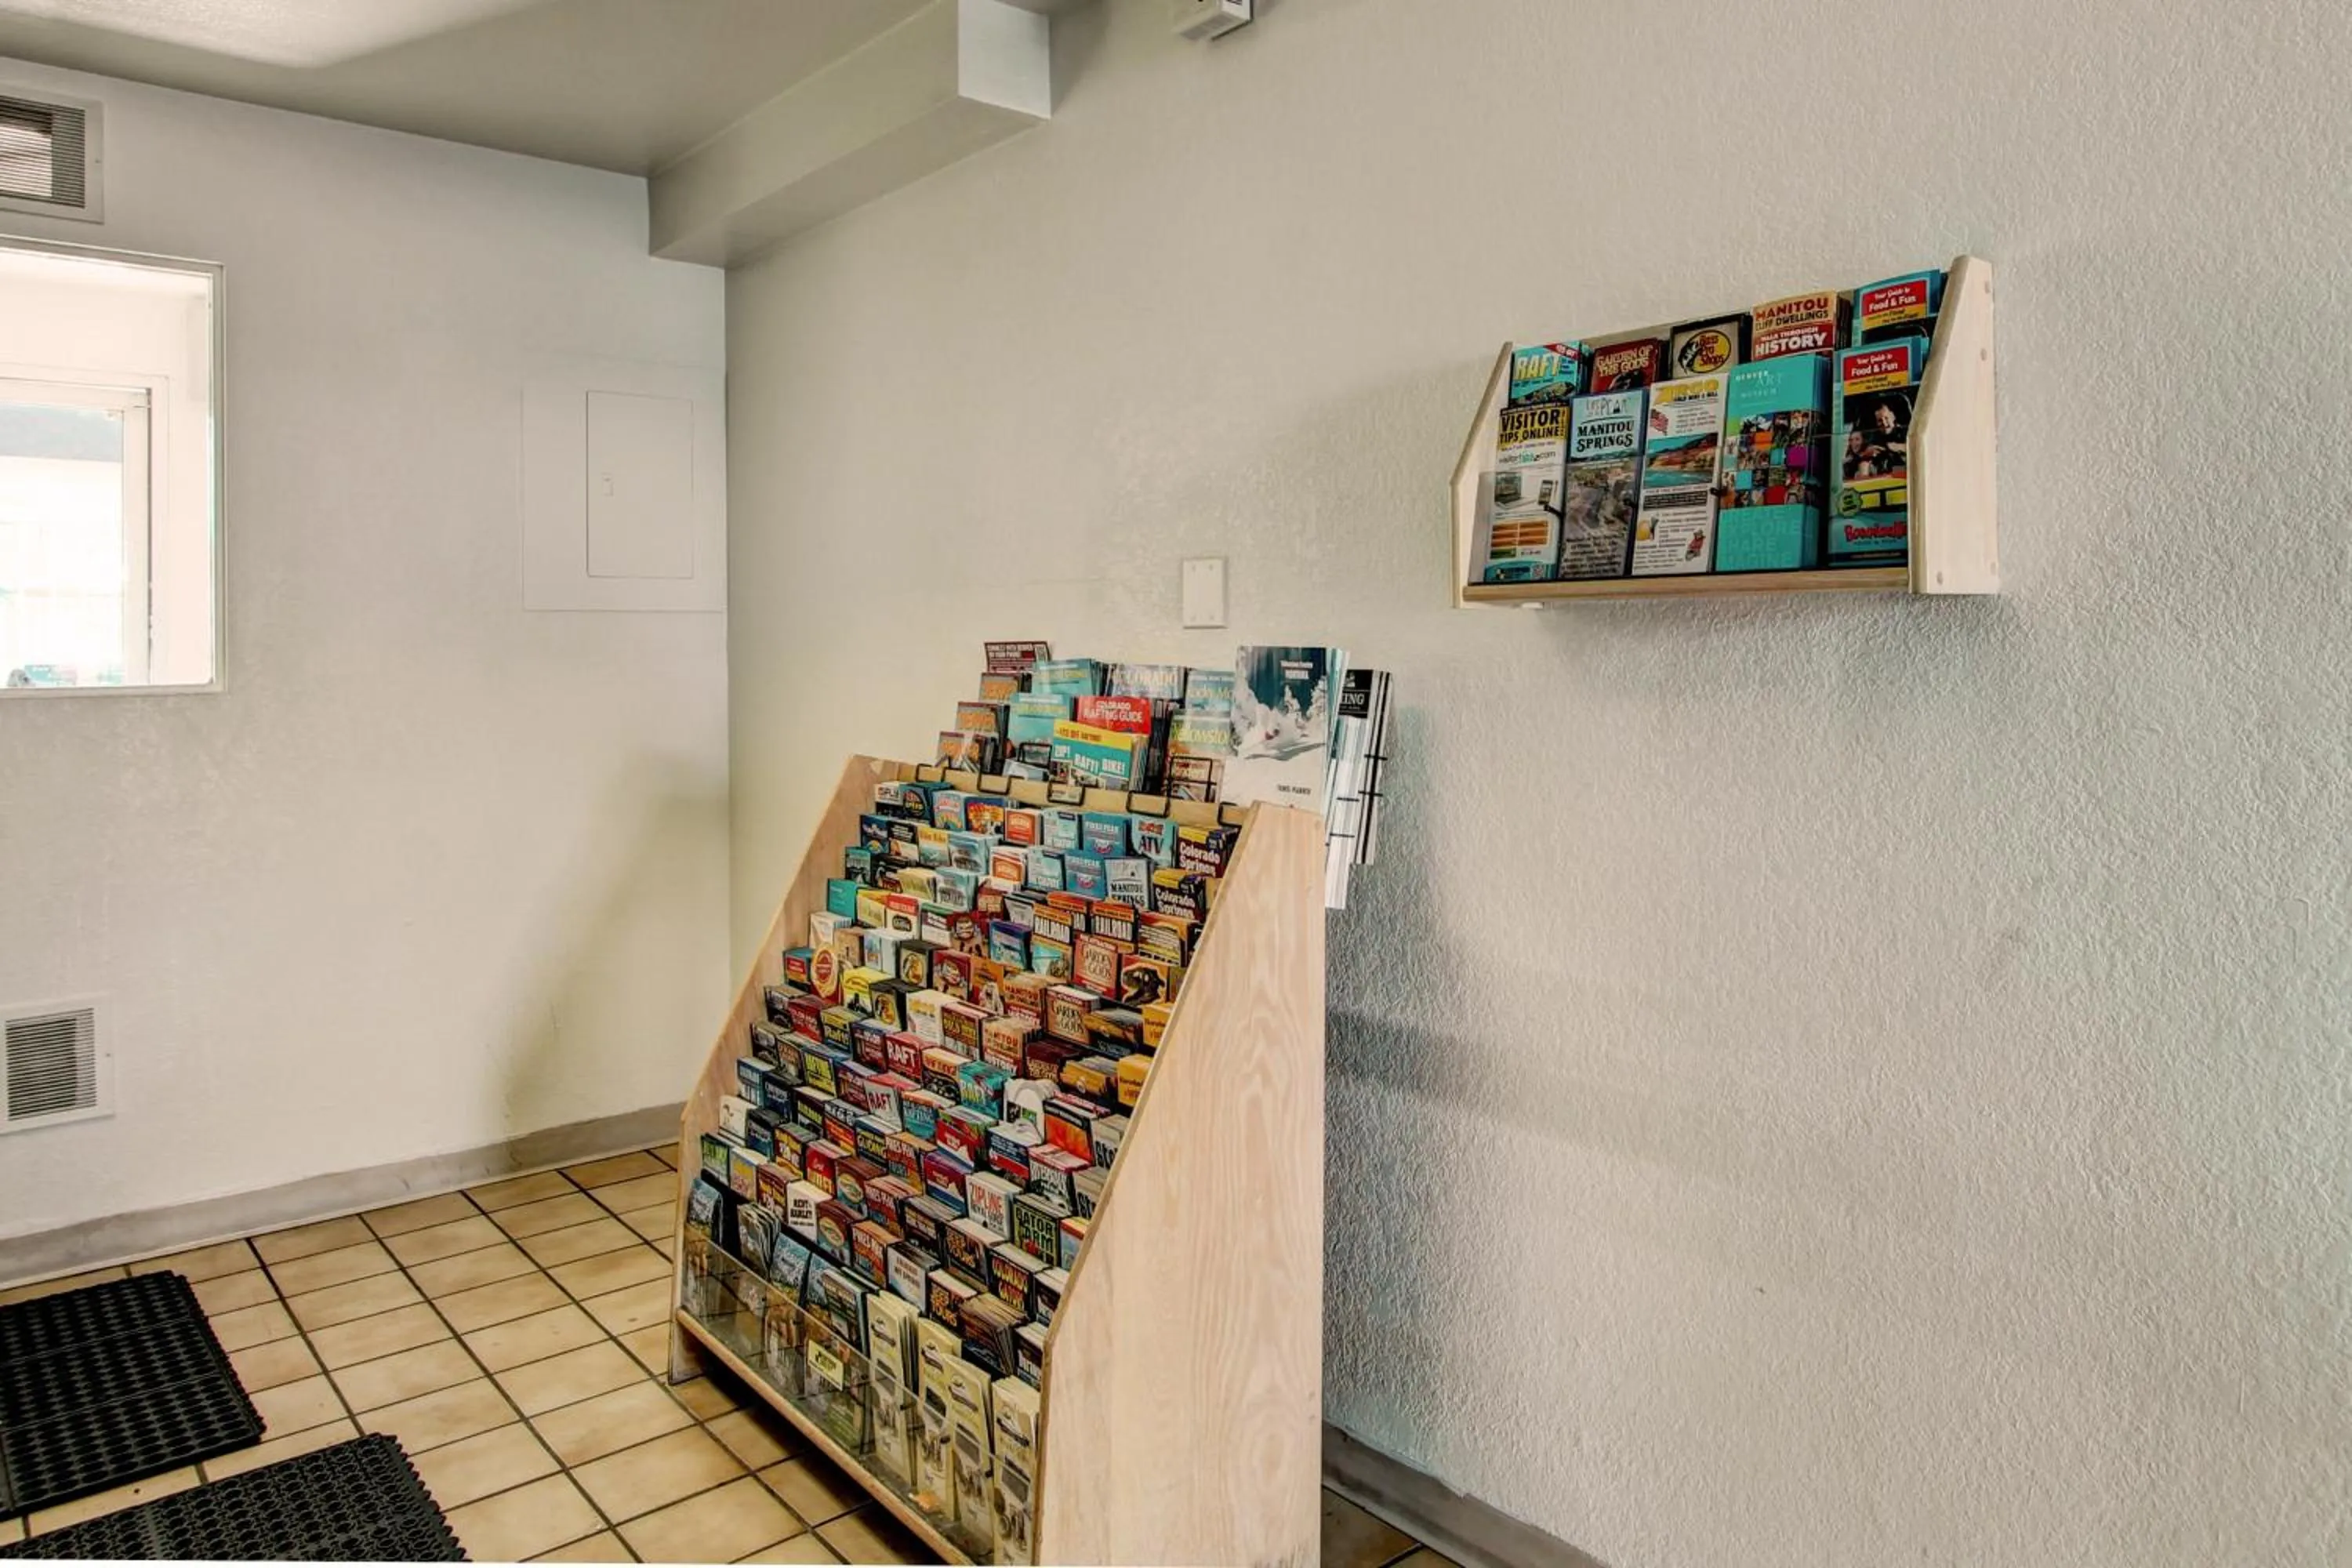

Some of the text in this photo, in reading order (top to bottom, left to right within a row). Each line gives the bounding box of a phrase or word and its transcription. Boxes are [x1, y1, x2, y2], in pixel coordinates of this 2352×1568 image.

[1755, 298, 1829, 320] MANITOU
[1868, 296, 1916, 312] Food & Fun
[1775, 310, 1829, 326] DWELLINGS
[1780, 326, 1818, 337] THROUGH
[1755, 332, 1827, 356] HISTORY
[1516, 354, 1559, 379] RAFT
[1595, 346, 1653, 370] GARDEN OF
[1621, 357, 1648, 372] GODS
[1735, 370, 1769, 382] DENVER
[1851, 362, 1898, 376] Food & Fun
[1755, 372, 1785, 388] ART
[1501, 408, 1560, 432] VISITOR
[1577, 420, 1635, 437] MANITOU
[1499, 426, 1559, 445] TIPS ONLINE
[1577, 434, 1634, 452] SPRINGS
[1096, 700, 1131, 710] COLORADO
[1084, 708, 1144, 723] RAFTING GUIDE
[1139, 836, 1163, 855] ATV
[1180, 842, 1221, 865] Colorado
[1179, 856, 1216, 877] Springs
[1110, 883, 1144, 894] MANITOU
[1155, 887, 1196, 909] Colorado
[1157, 902, 1196, 920] Springs
[887, 1040, 916, 1069] RAFT
[1015, 1207, 1054, 1237] GATOR
